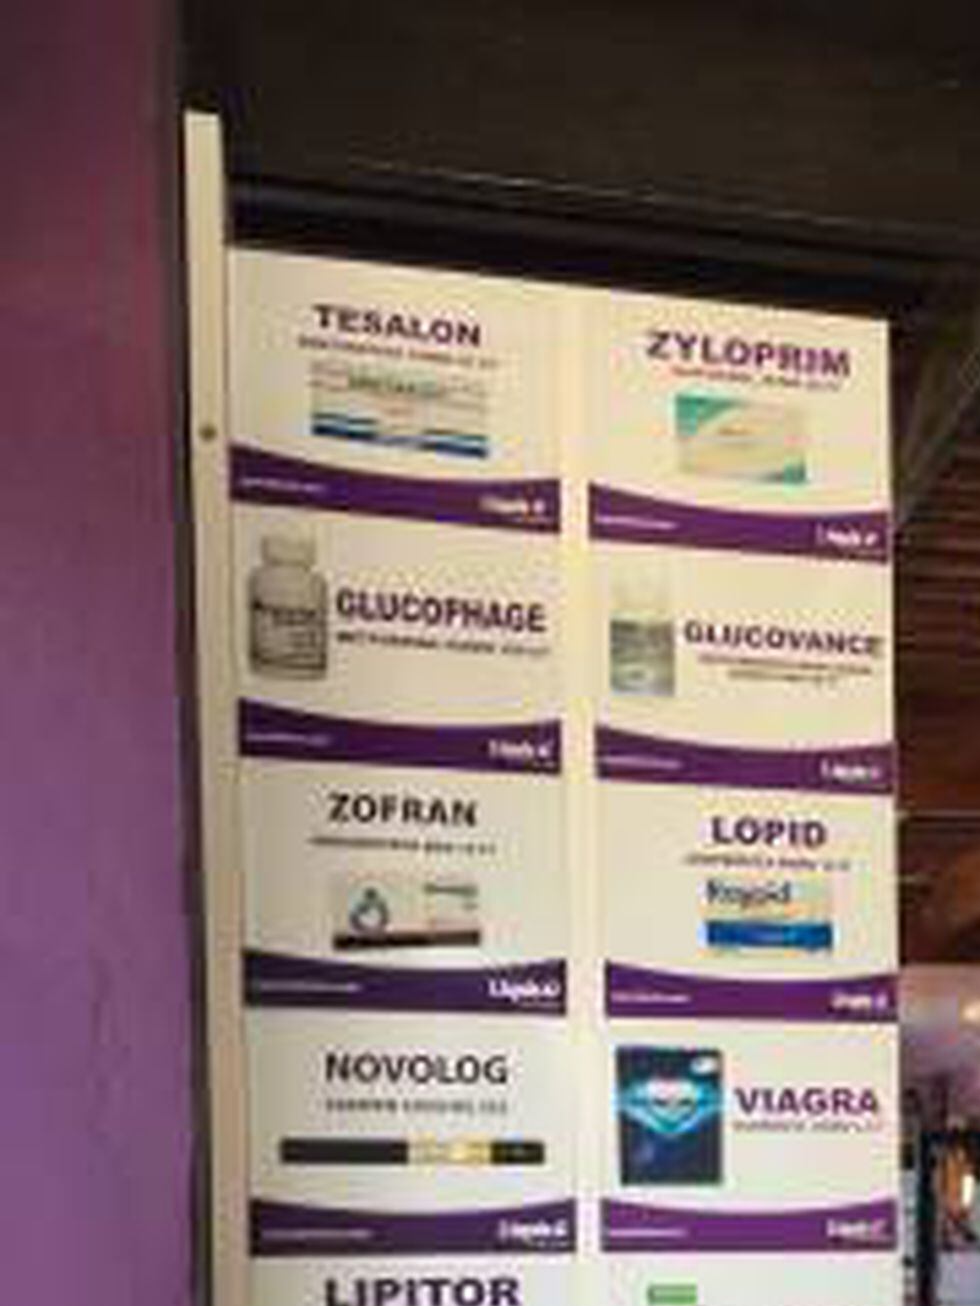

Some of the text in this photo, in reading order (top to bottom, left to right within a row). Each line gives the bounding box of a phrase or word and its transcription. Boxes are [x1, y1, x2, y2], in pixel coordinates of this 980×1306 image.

[313, 302, 481, 347] TESALON
[646, 329, 851, 378] ZYLOPRIM
[328, 791, 477, 828] ZOFRAN
[711, 816, 828, 848] LOPID
[325, 1052, 509, 1085] NOVOLOG
[734, 1087, 880, 1116] VIAGRA
